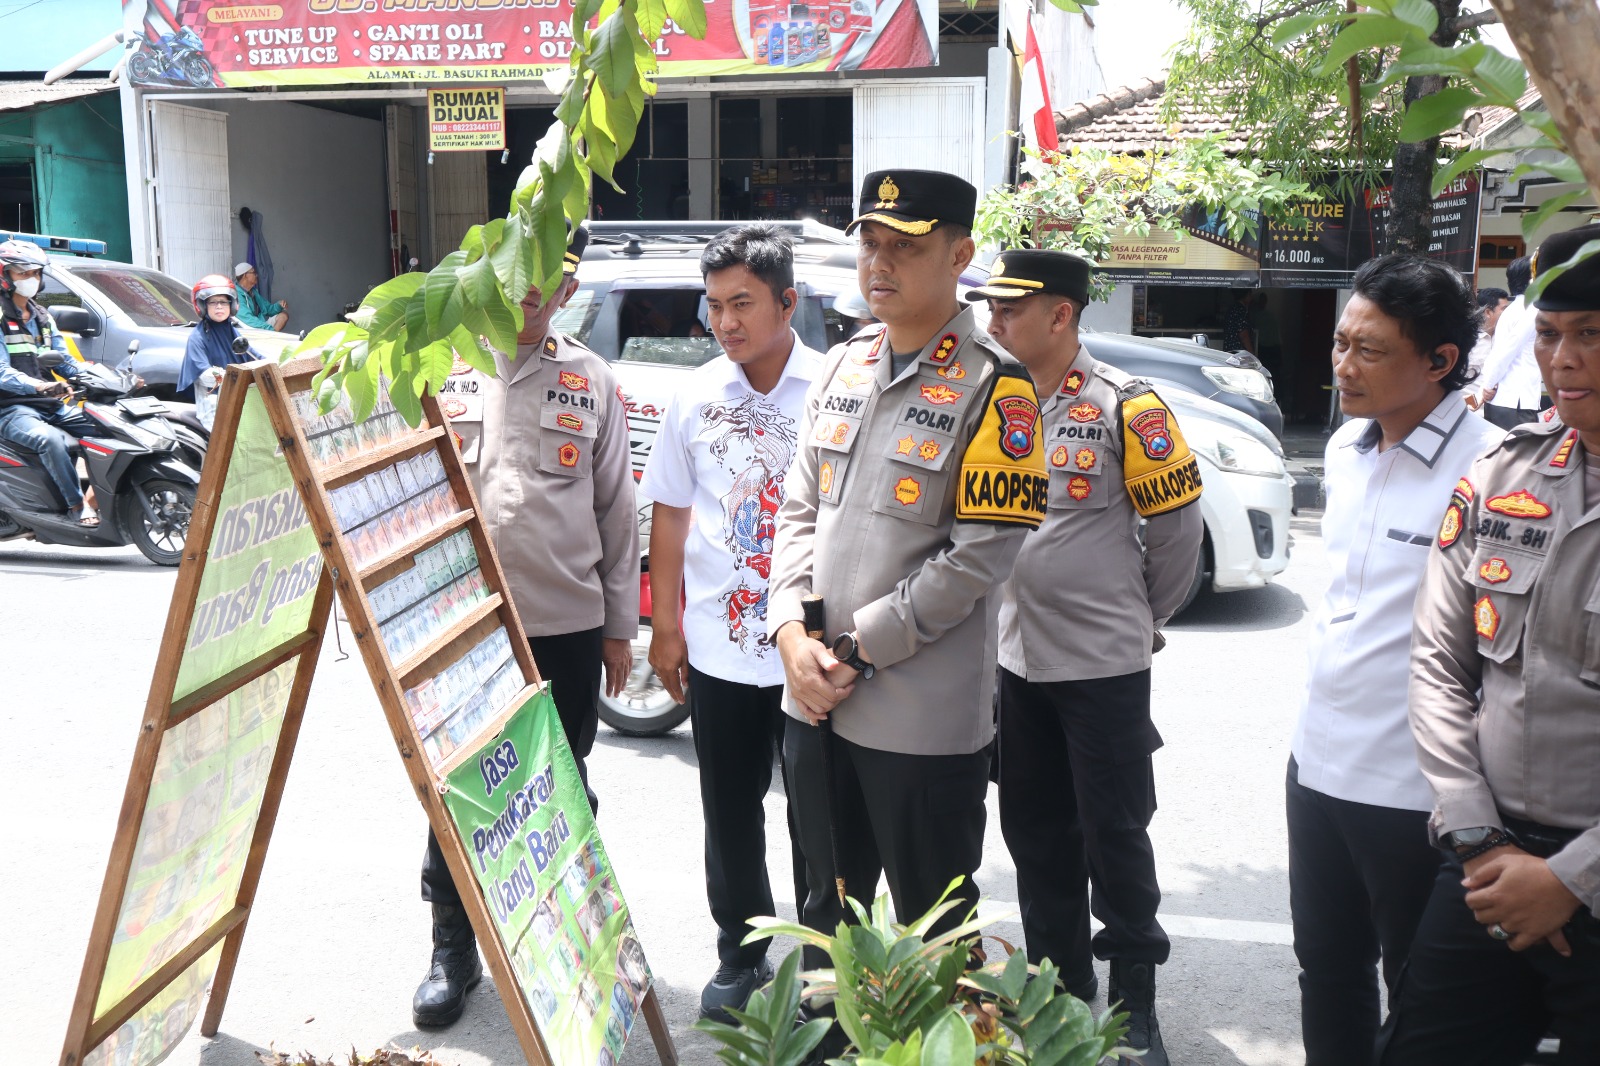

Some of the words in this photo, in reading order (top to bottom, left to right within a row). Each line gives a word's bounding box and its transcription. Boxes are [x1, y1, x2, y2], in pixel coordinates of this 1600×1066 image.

[214, 8, 270, 20] MELAYANI
[244, 28, 304, 46] TUNE
[308, 26, 338, 44] UP
[367, 24, 440, 42] GANTI
[444, 23, 483, 40] OLI
[248, 46, 339, 65] SERVICE
[368, 44, 442, 62] SPARE
[446, 42, 505, 60] PART
[367, 70, 416, 79] ALAMAT
[423, 70, 440, 79] JL.
[443, 69, 489, 79] BASUKI
[491, 67, 543, 78] RAHMAD
[433, 91, 499, 107] RUMAH
[434, 106, 499, 122] DIJUAL
[432, 124, 448, 132] HUB
[1448, 197, 1467, 208] HALUS
[1441, 212, 1461, 222] BASAH
[1439, 226, 1459, 236] MULUT
[1116, 253, 1142, 261] TANPA
[1143, 253, 1169, 261] FILTER
[1131, 245, 1180, 254] LEGENDARIS
[1274, 249, 1311, 263] 16.000
[547, 389, 595, 411] POLRI
[824, 395, 864, 415] BOBBY
[904, 406, 956, 433] POLRI
[1056, 425, 1102, 441] POLRI
[1521, 526, 1548, 549] SH
[480, 738, 519, 797] Jasa
[472, 763, 556, 874] Penukaran
[488, 856, 536, 924] Uang
[525, 809, 571, 875] Baru
